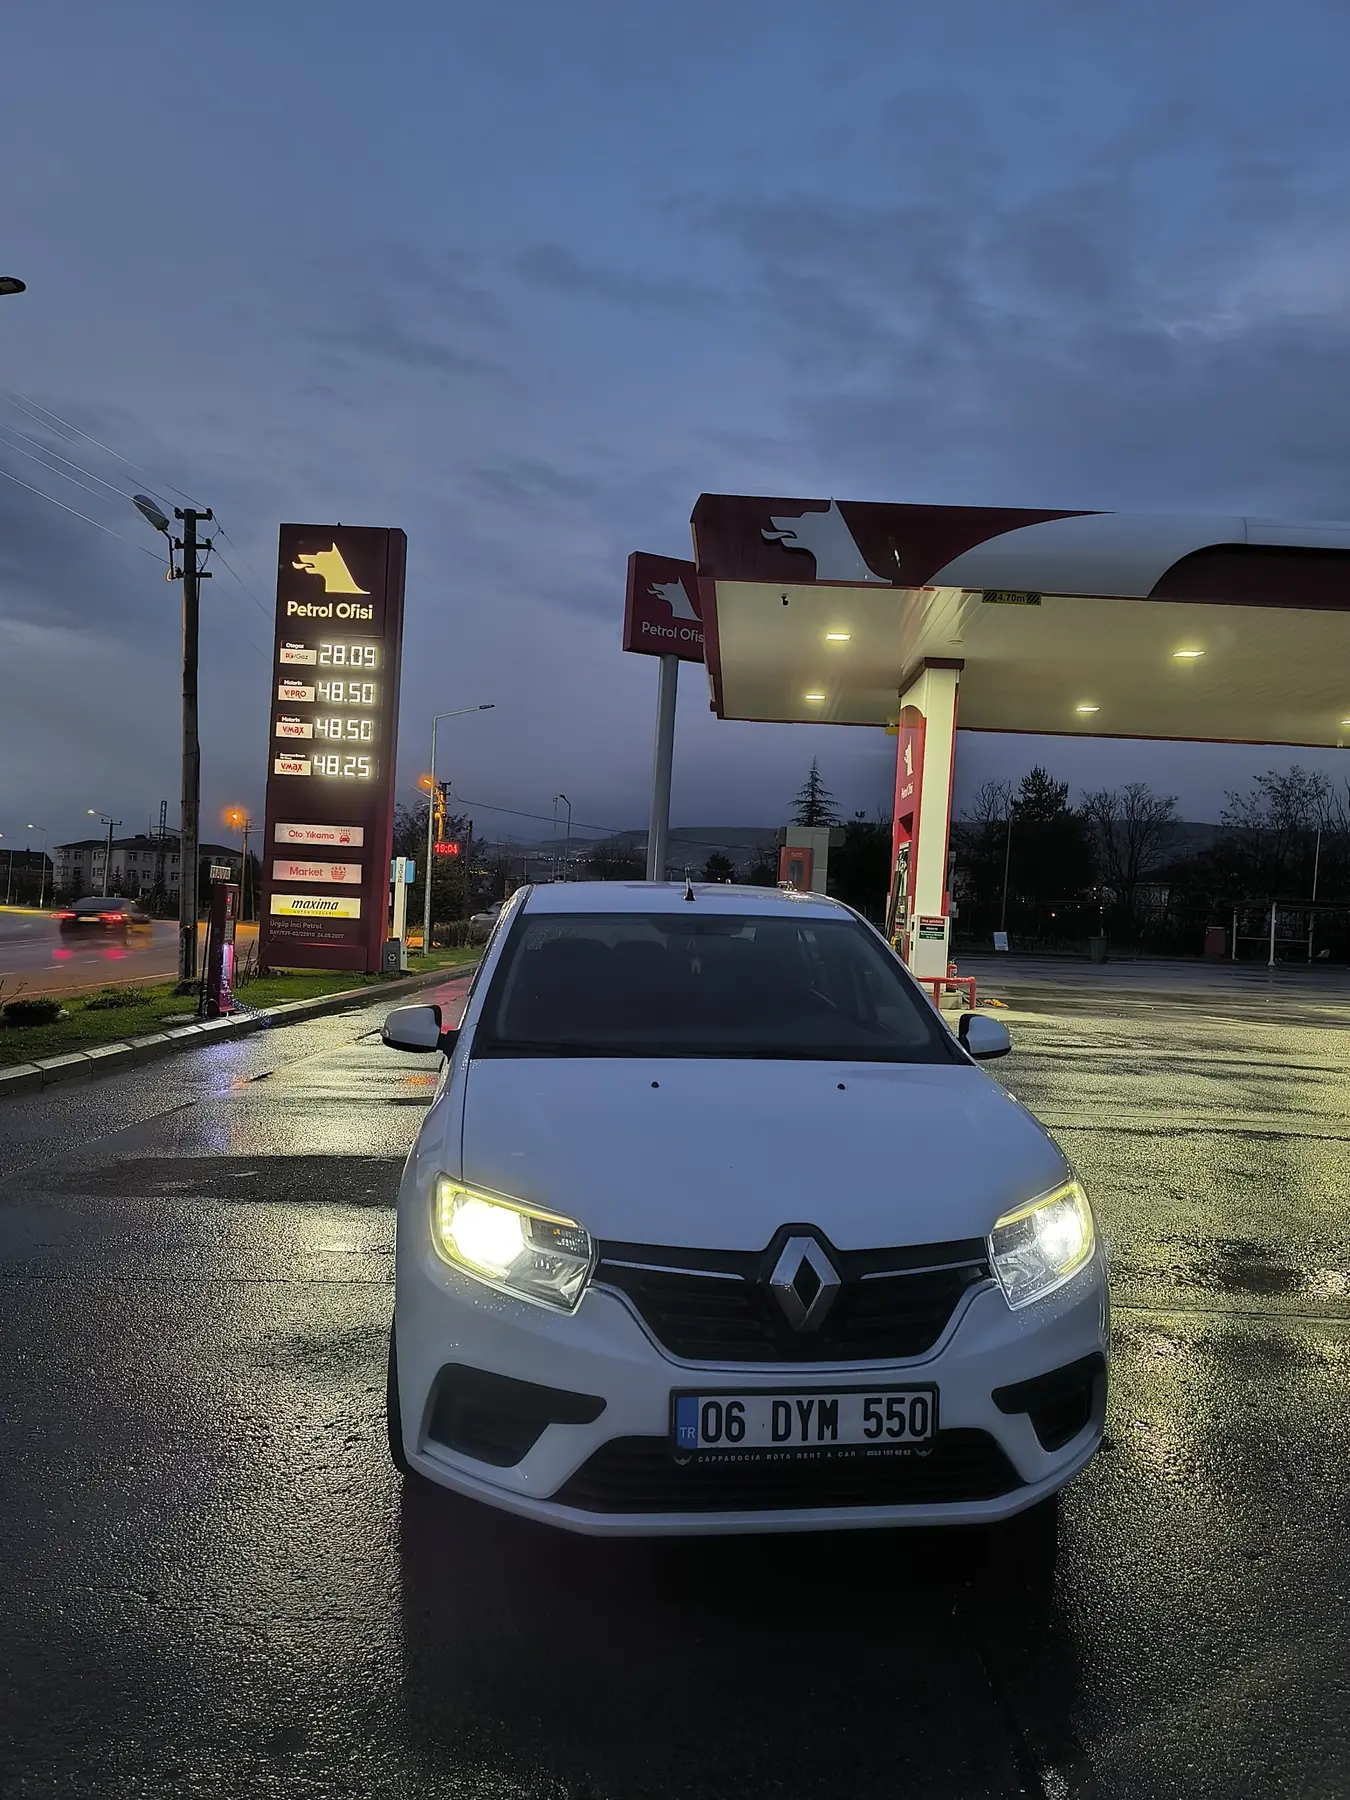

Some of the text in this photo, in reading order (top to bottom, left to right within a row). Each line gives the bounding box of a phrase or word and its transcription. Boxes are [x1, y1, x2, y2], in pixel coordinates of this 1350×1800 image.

[997, 593, 1025, 602] 4.70m
[287, 601, 373, 620] Petrol Ofisi
[641, 621, 705, 643] Petrol Ofis
[320, 643, 376, 667] 28.09
[318, 681, 374, 703] 48.50
[316, 718, 372, 740] 48.50
[313, 755, 370, 777] 48.25
[288, 829, 335, 840] Oto Yıkama
[211, 867, 230, 879] HAVA
[289, 866, 323, 877] Market
[291, 898, 339, 910] maxima
[680, 1396, 929, 1443] TR 06 DYM 550
[698, 1454, 761, 1463] CAPPADOCIA
[837, 1450, 856, 1458] CAR
